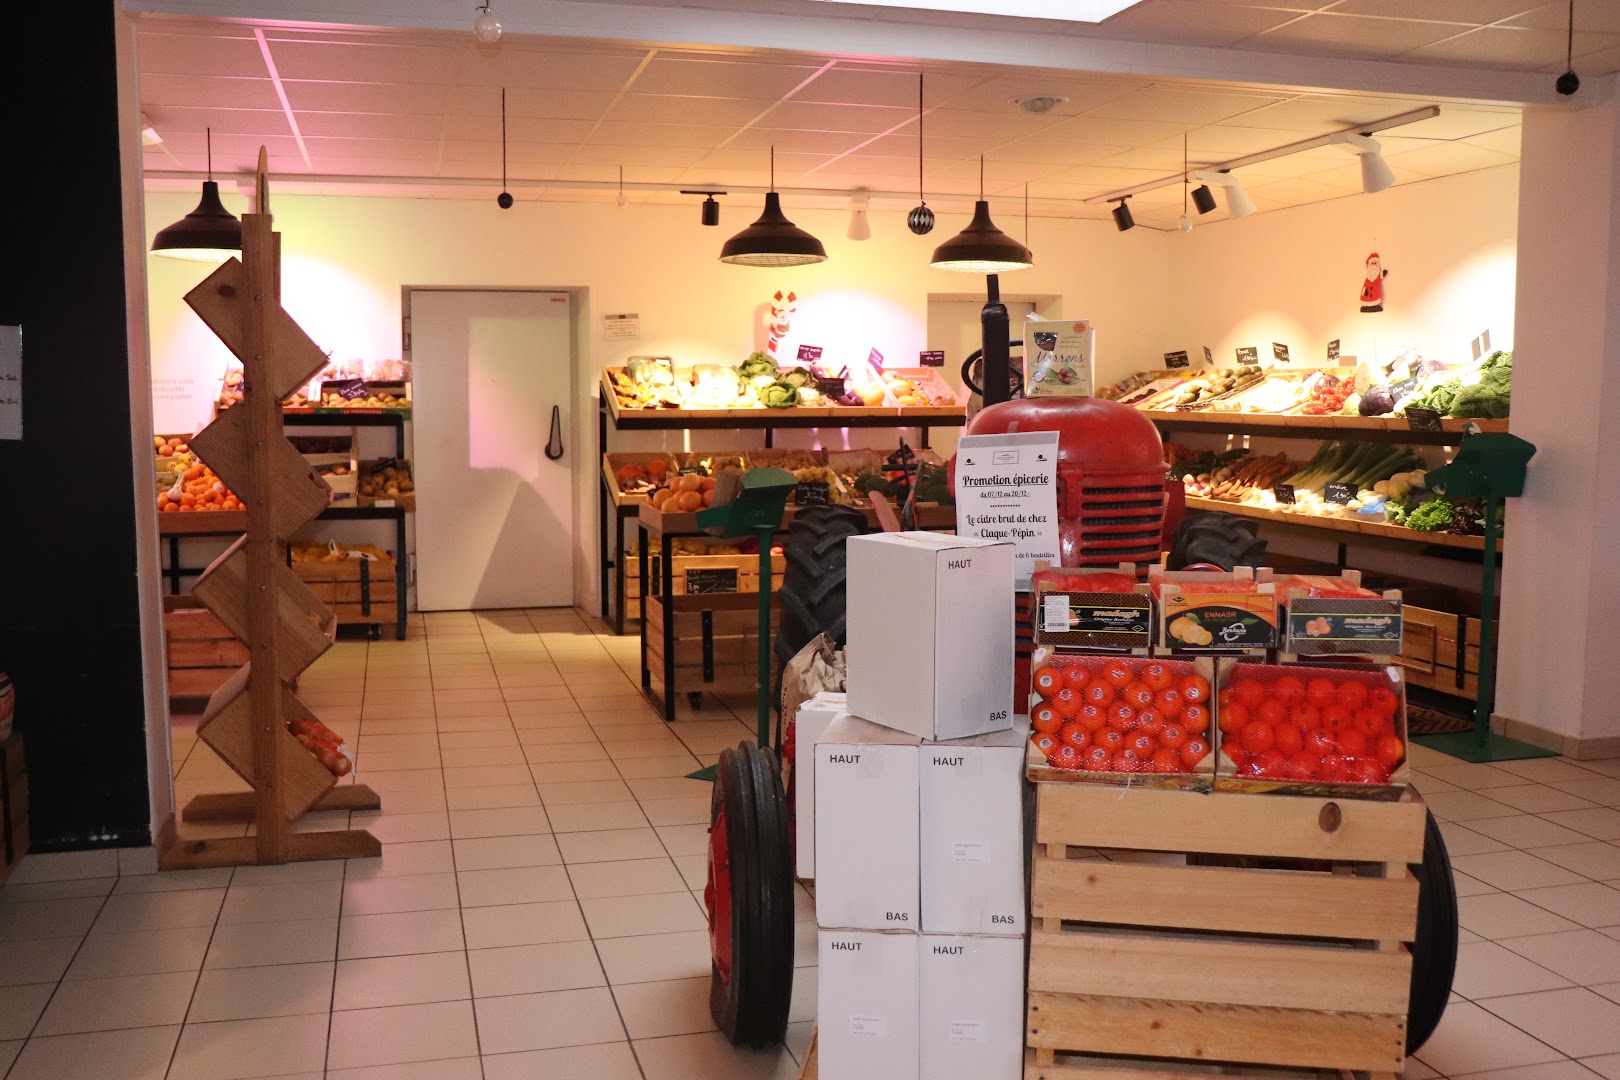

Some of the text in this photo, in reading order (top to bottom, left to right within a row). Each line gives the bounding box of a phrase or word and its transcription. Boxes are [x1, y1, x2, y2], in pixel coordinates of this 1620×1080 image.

[962, 473, 1049, 488] Promotion épicerie
[987, 491, 1003, 499] 07/12
[1011, 490, 1027, 498] 20/12
[966, 514, 1047, 526] Le cidre brut de chez
[980, 528, 1036, 541] Claque-Pépin
[948, 559, 972, 570] HAUT
[1092, 609, 1140, 618] madagh
[1344, 616, 1392, 625] madagh
[989, 711, 1007, 721] BAS
[829, 754, 861, 764] HAUT
[933, 757, 964, 766] HAUT
[886, 912, 909, 921] BAS
[991, 915, 1015, 924] BAS
[831, 942, 862, 951] HAUT
[933, 945, 964, 955] HAUT
